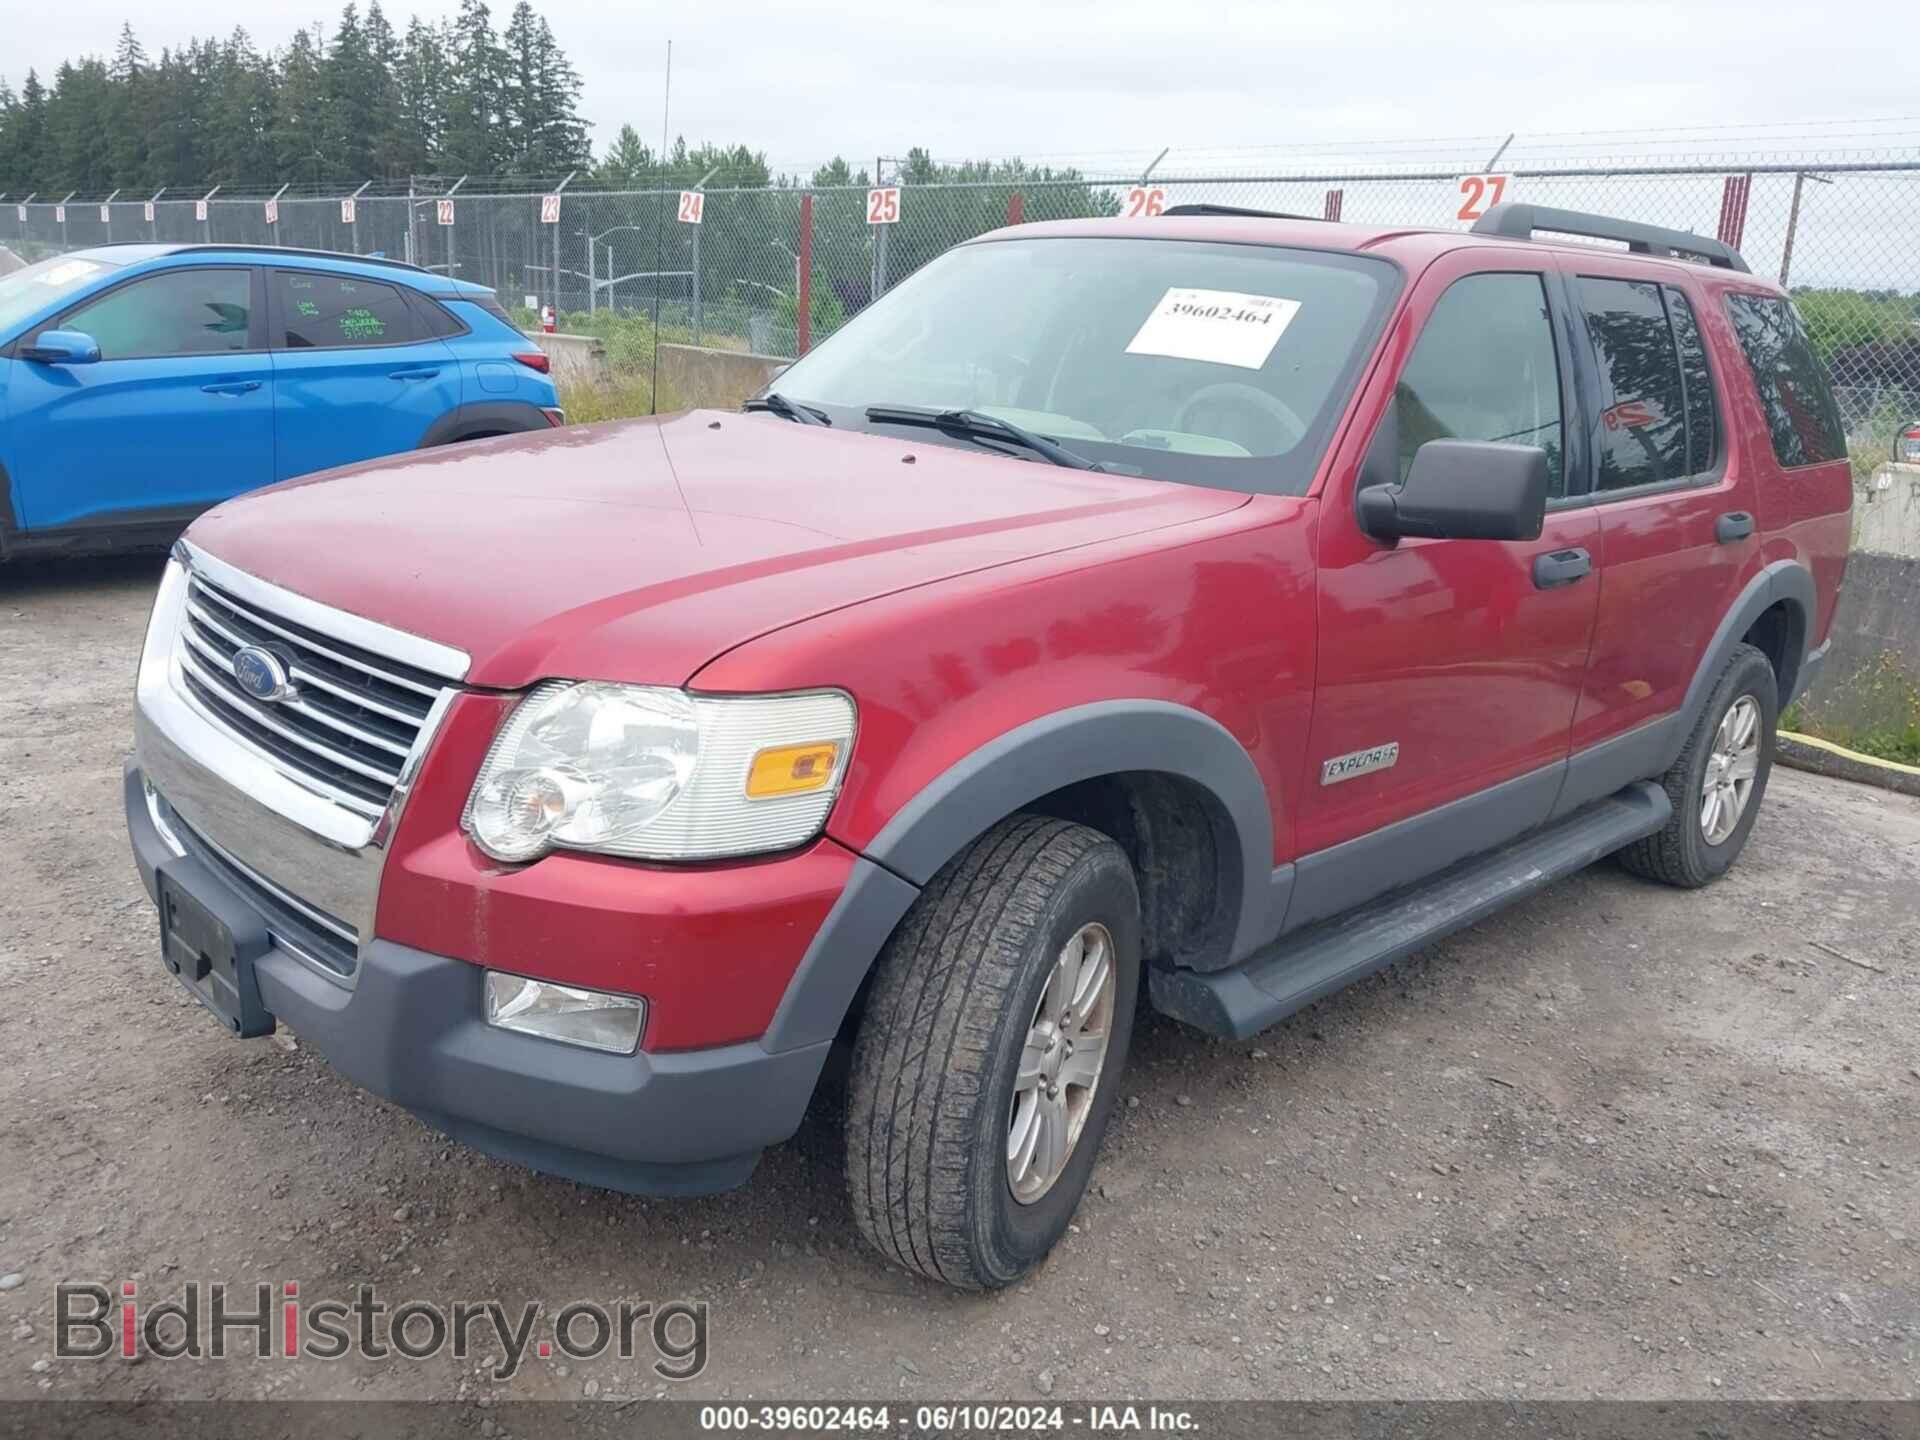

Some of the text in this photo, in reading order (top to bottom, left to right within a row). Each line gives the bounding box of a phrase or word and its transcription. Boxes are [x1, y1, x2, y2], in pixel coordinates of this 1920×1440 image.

[439, 201, 454, 223] 22
[544, 197, 559, 220] 23
[680, 194, 701, 222] 24
[869, 191, 897, 222] 25
[1128, 189, 1164, 217] 26
[1457, 176, 1506, 220] 27
[1165, 302, 1273, 325] 39602464
